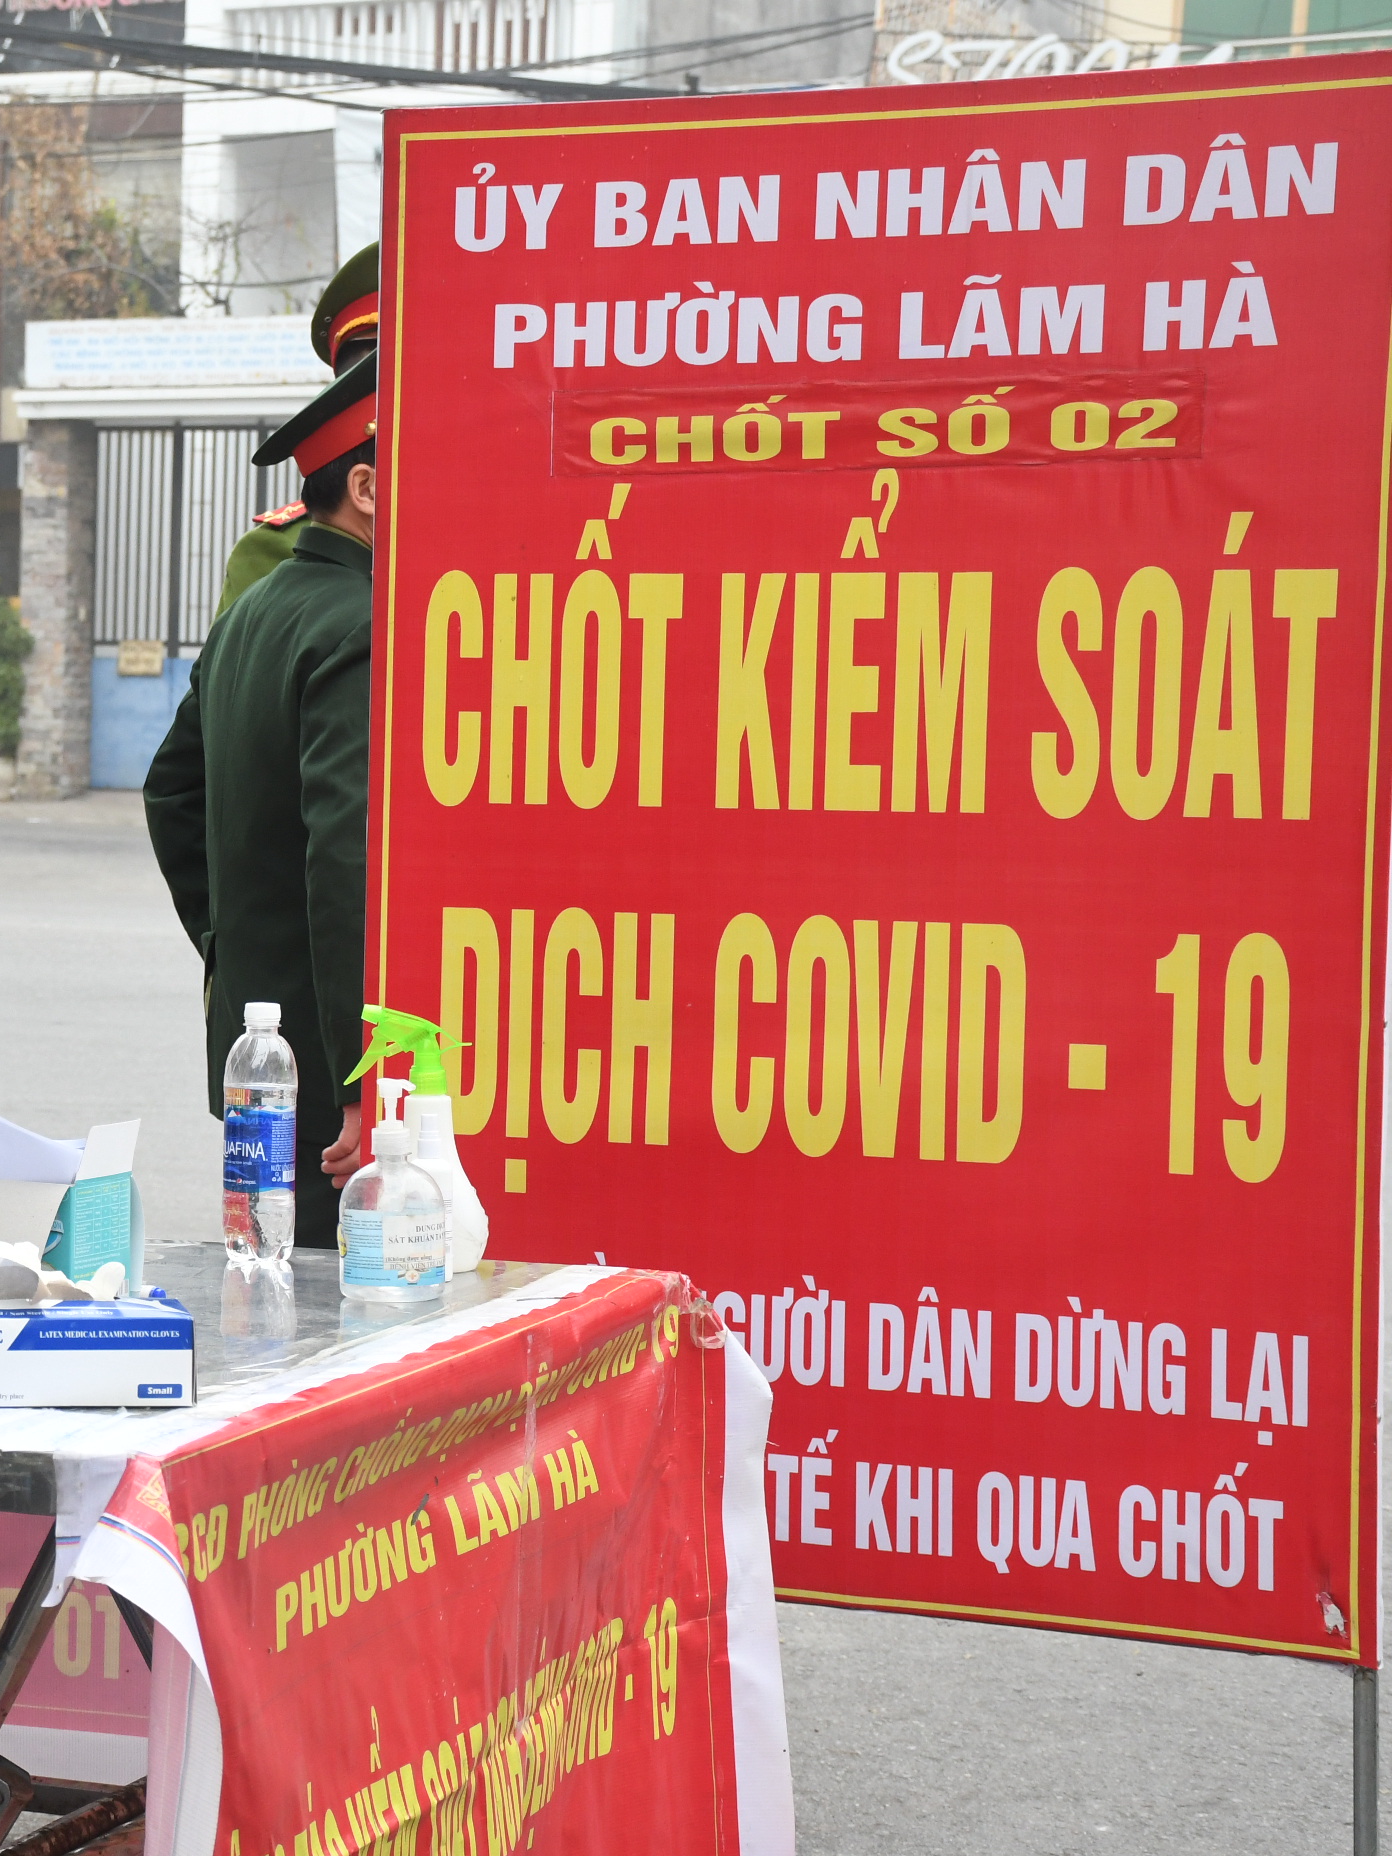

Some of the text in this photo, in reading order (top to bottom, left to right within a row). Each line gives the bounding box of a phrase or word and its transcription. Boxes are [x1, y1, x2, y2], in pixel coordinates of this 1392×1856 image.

[453, 132, 1339, 253] ỦY BAN NHÂN DÂN
[493, 260, 1279, 369] PHƯỜNG LÃM HÀ
[590, 384, 1179, 466] CHỐT SỐ 02
[421, 467, 1340, 820] CHỐT KIỂM SOÁT
[442, 906, 1291, 1194] DỊCH COVID - 19
[39, 1330, 180, 1339] LATEX MEDICAL EXAMINATION GLOVES
[147, 1387, 173, 1395] Small
[701, 1275, 1311, 1446] GƯỜI DÂN DỪNG LẠI
[237, 1458, 338, 1560] PHÒNG
[275, 1429, 600, 1653] PHƯỜNG LÃM HÀ
[767, 1428, 1285, 1593] TẾ KHI QUA CHỐT
[644, 1597, 678, 1740] 19
